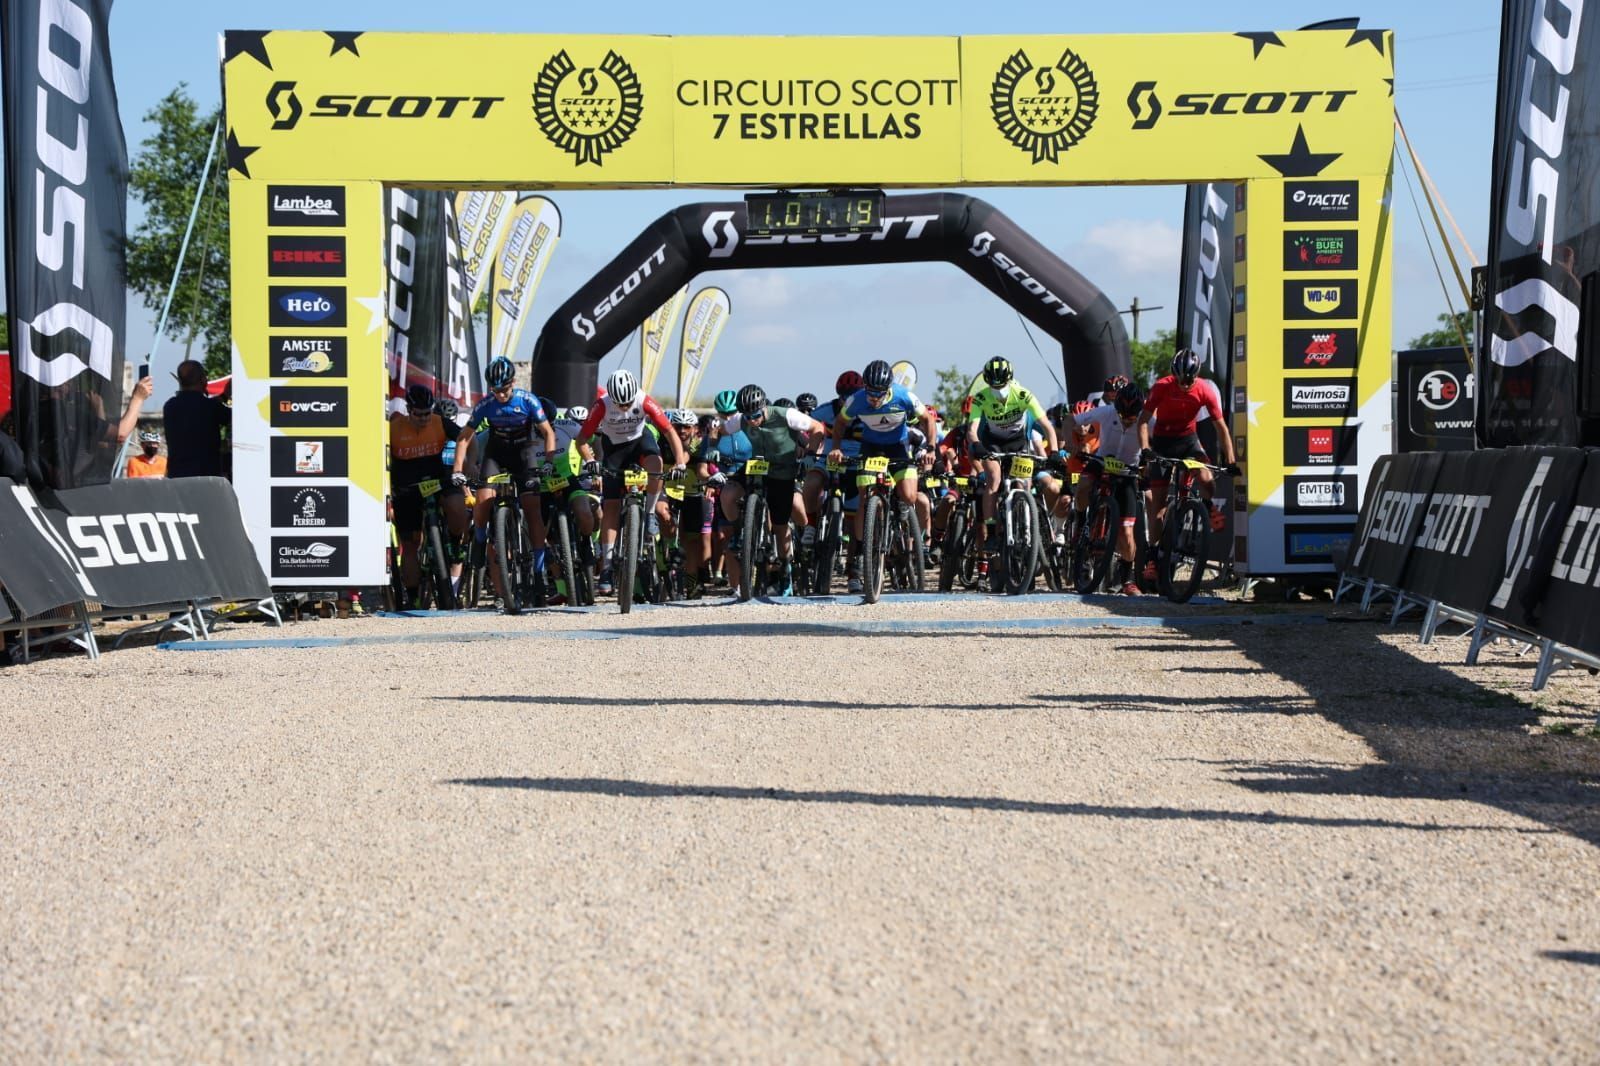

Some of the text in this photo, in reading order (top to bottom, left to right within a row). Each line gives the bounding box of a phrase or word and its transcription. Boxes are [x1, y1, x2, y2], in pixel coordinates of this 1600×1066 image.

[676, 79, 958, 107] CIRCUITO SCOTT
[1017, 96, 1073, 105] SCOTT
[309, 95, 505, 118] SCOTT
[560, 98, 617, 106] SCOTT
[1168, 90, 1358, 116] SCOTT
[713, 113, 922, 140] 7 ESTRELLAS
[274, 195, 333, 210] Lambea
[1307, 193, 1351, 206] TACTIC
[1316, 241, 1343, 249] BUEN
[511, 222, 550, 305] X-SAUCE
[593, 243, 667, 323] SCOTT
[991, 252, 1078, 317] SCOTT
[1307, 290, 1338, 302] WD-40
[288, 297, 331, 312] Hero
[282, 340, 331, 351] AMSTEL
[1295, 389, 1346, 400] Avimosa
[280, 401, 336, 412] TowCar
[1014, 464, 1032, 474] 1160
[1299, 484, 1343, 494] EMTBM
[1369, 490, 1427, 545] SCOT
[1415, 493, 1492, 557] SCOTT
[67, 512, 205, 568] SCOTT
